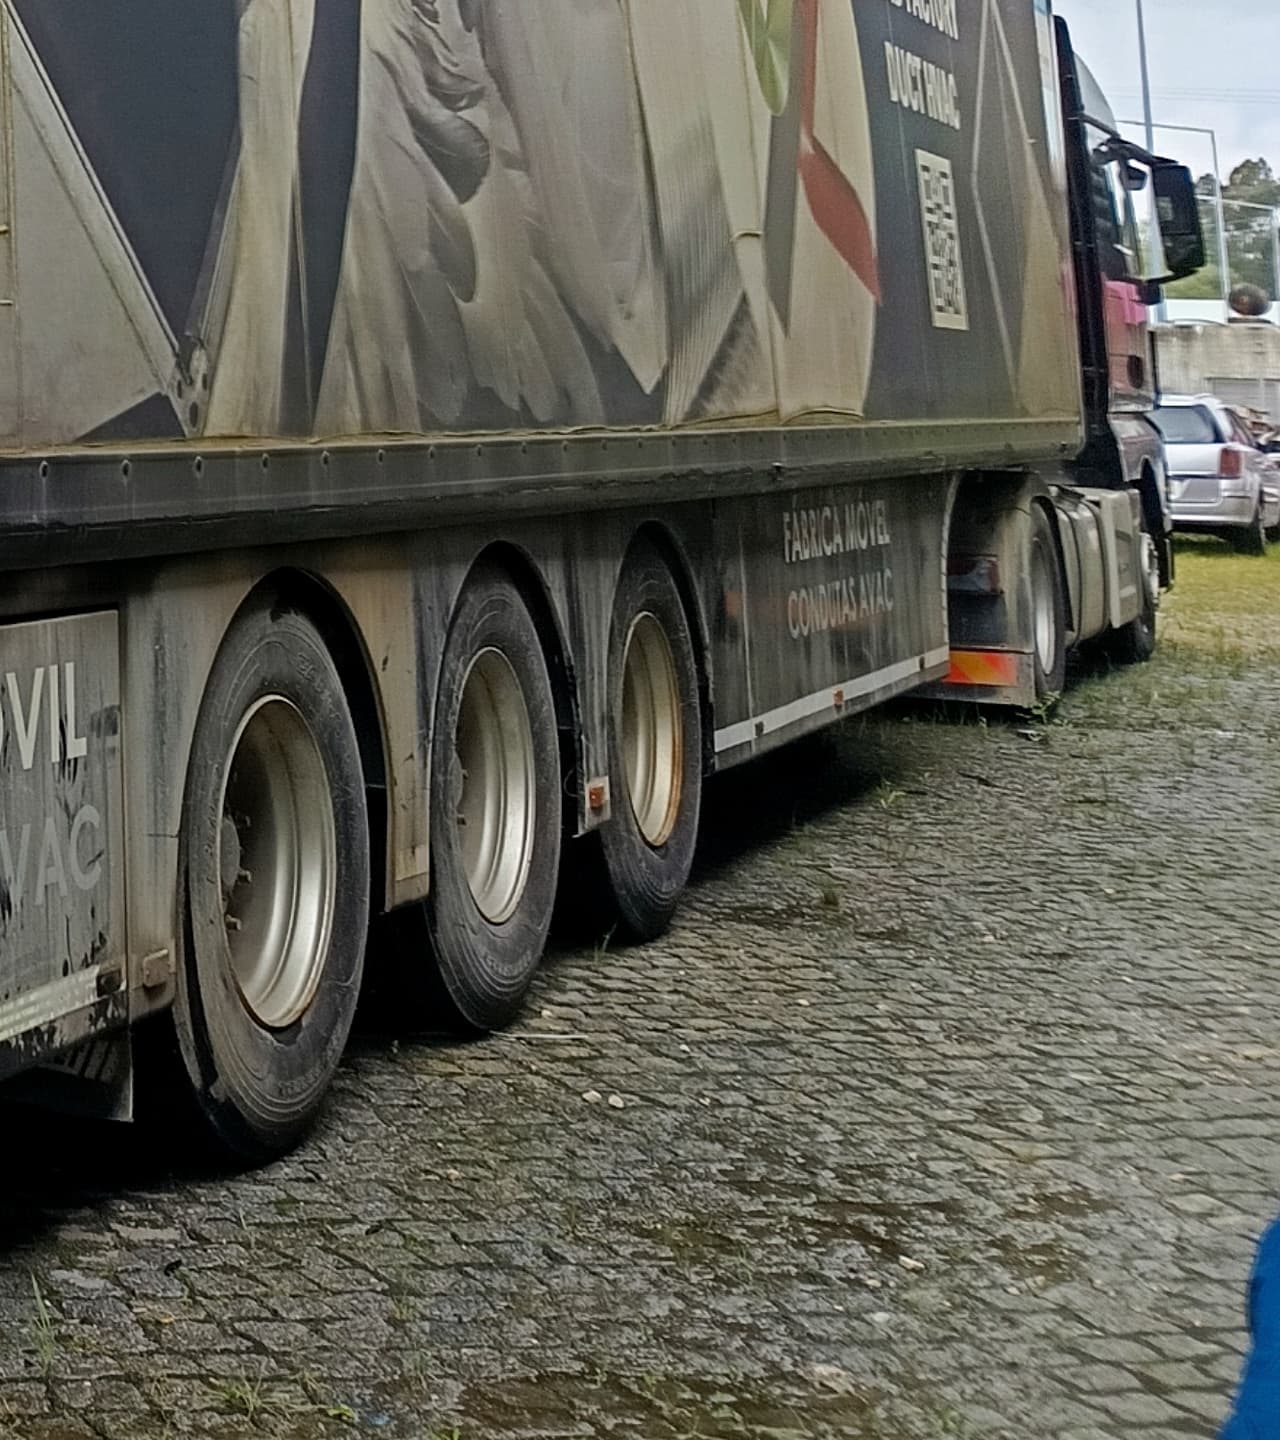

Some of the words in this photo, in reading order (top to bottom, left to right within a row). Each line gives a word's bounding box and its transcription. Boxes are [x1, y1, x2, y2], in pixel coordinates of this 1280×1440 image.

[884, 40, 926, 115] DUCT
[922, 59, 961, 130] HVAC
[782, 493, 844, 564] FÁBRICA
[844, 487, 891, 552] MÓVEL
[787, 575, 857, 640] CONDUTAS
[859, 567, 894, 619] AVAC
